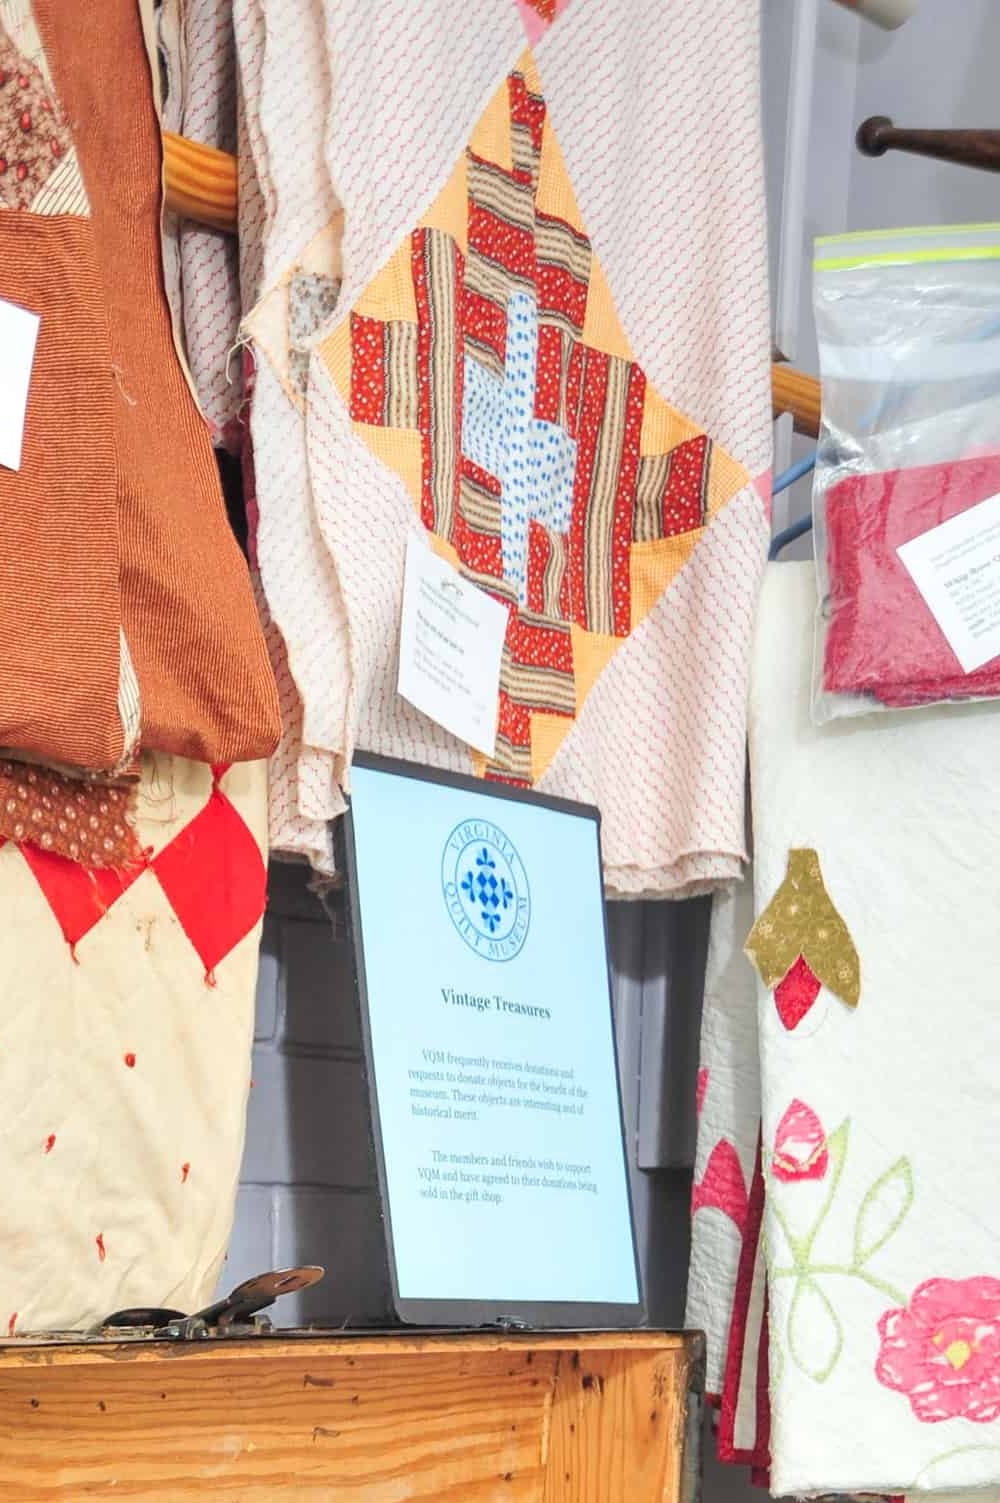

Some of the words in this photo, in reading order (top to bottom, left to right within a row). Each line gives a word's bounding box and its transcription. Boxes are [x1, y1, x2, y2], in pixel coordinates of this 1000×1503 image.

[450, 822, 515, 865] VIRGINIA
[445, 881, 481, 946] QUILT
[488, 896, 528, 959] MUSEUM
[441, 987, 491, 1012] Vintage
[492, 994, 552, 1020] Treasures
[421, 1048, 445, 1065] VQM
[446, 1050, 489, 1070] frequently
[560, 1065, 574, 1080] and
[408, 1069, 445, 1085] requests
[446, 1070, 456, 1082] to
[457, 1071, 486, 1085] donate
[487, 1075, 516, 1090] objects
[517, 1078, 529, 1090] for
[529, 1080, 541, 1091] the
[542, 1081, 567, 1096] benefit
[567, 1085, 576, 1096] of
[451, 1087, 477, 1103] These
[478, 1092, 507, 1108] objects
[411, 1104, 452, 1119] historical
[431, 1150, 448, 1163] The
[449, 1152, 489, 1166] members
[490, 1154, 506, 1167] and
[507, 1155, 536, 1169] friends
[537, 1157, 554, 1170] wish
[555, 1160, 563, 1172] to
[564, 1162, 592, 1176] support
[417, 1167, 441, 1183] VQM
[442, 1168, 458, 1182] and
[459, 1169, 480, 1183] have
[481, 1172, 510, 1187] agreed
[511, 1174, 520, 1185] to
[521, 1174, 540, 1187] their
[420, 1185, 437, 1199] sold
[439, 1187, 449, 1199] in
[449, 1187, 464, 1201] the
[465, 1188, 480, 1204] gift
